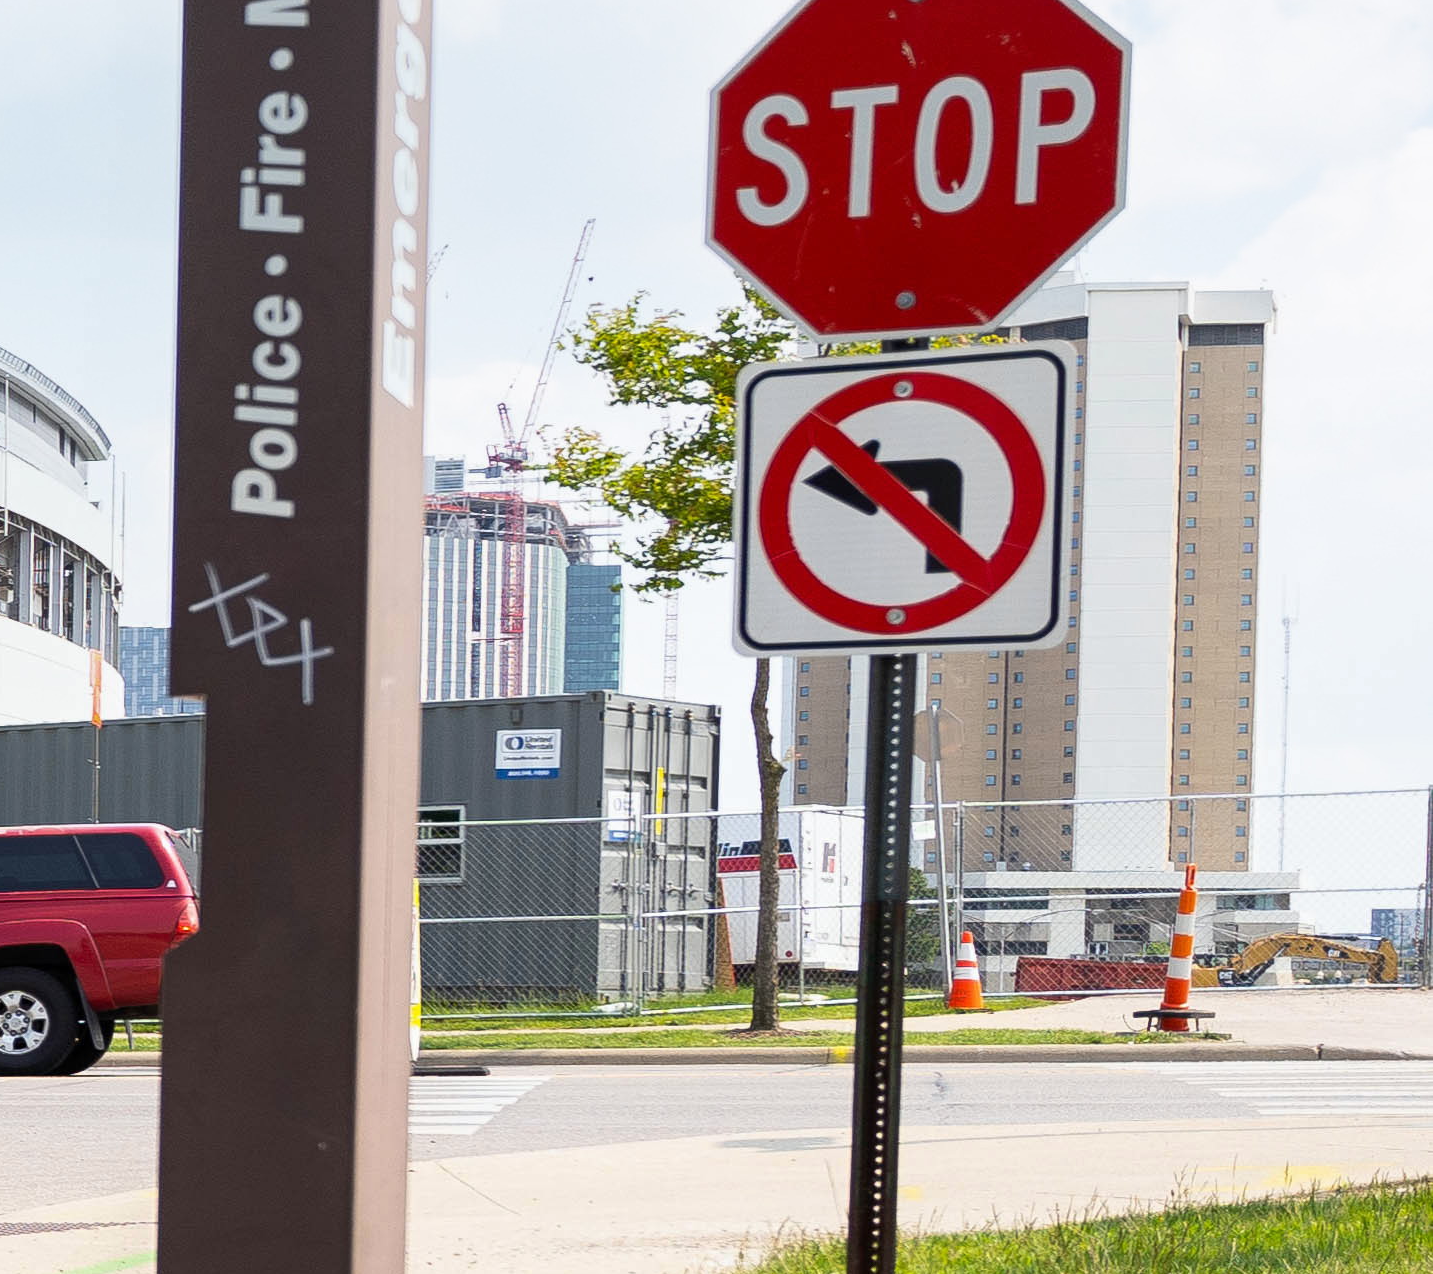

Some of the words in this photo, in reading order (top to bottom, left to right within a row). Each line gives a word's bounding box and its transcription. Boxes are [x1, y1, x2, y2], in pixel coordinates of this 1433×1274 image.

[239, 91, 310, 234] Fire
[735, 67, 1096, 227] STOP
[231, 293, 303, 518] Police
